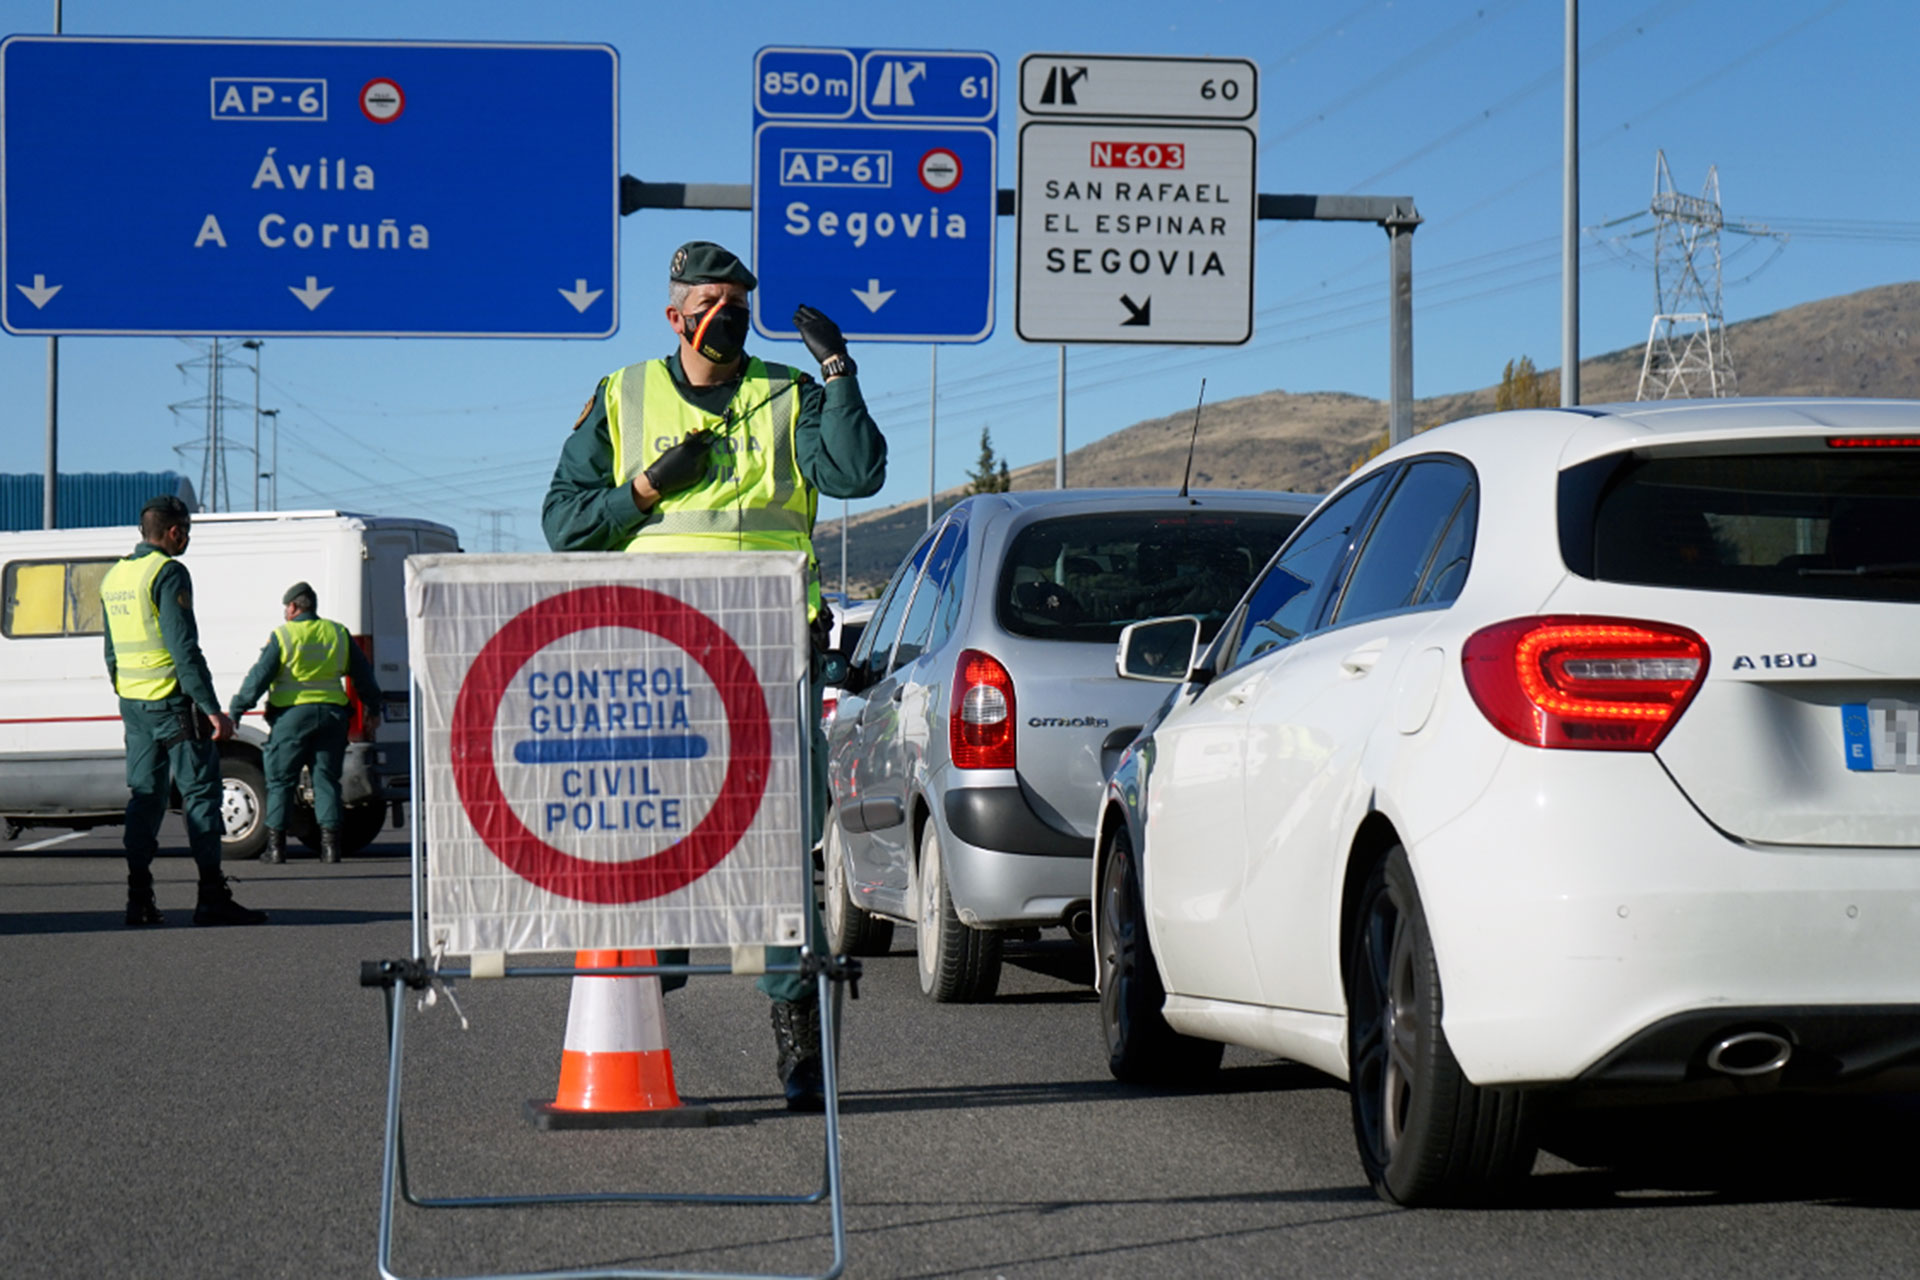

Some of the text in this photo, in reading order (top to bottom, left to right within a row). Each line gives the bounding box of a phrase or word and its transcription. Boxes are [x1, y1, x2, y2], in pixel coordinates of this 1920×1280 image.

[764, 71, 849, 97] 850 m
[960, 76, 989, 99] 61
[1200, 79, 1239, 101] 60
[219, 85, 319, 114] AP-6
[251, 147, 375, 190] Ávila
[785, 153, 886, 182] AP-61
[1093, 143, 1184, 167] N-603
[1045, 180, 1230, 203] SAN RAFAEL
[194, 213, 430, 250] A Coruña
[784, 201, 967, 249] Segovia
[1044, 213, 1227, 236] EL ESPINAR
[1046, 247, 1226, 277] SEGOVIA
[528, 667, 692, 701] CONTROL
[530, 700, 690, 734] GUARDIA
[1851, 743, 1864, 758] E
[562, 766, 660, 798] CIVIL
[546, 799, 681, 832] POLICE
